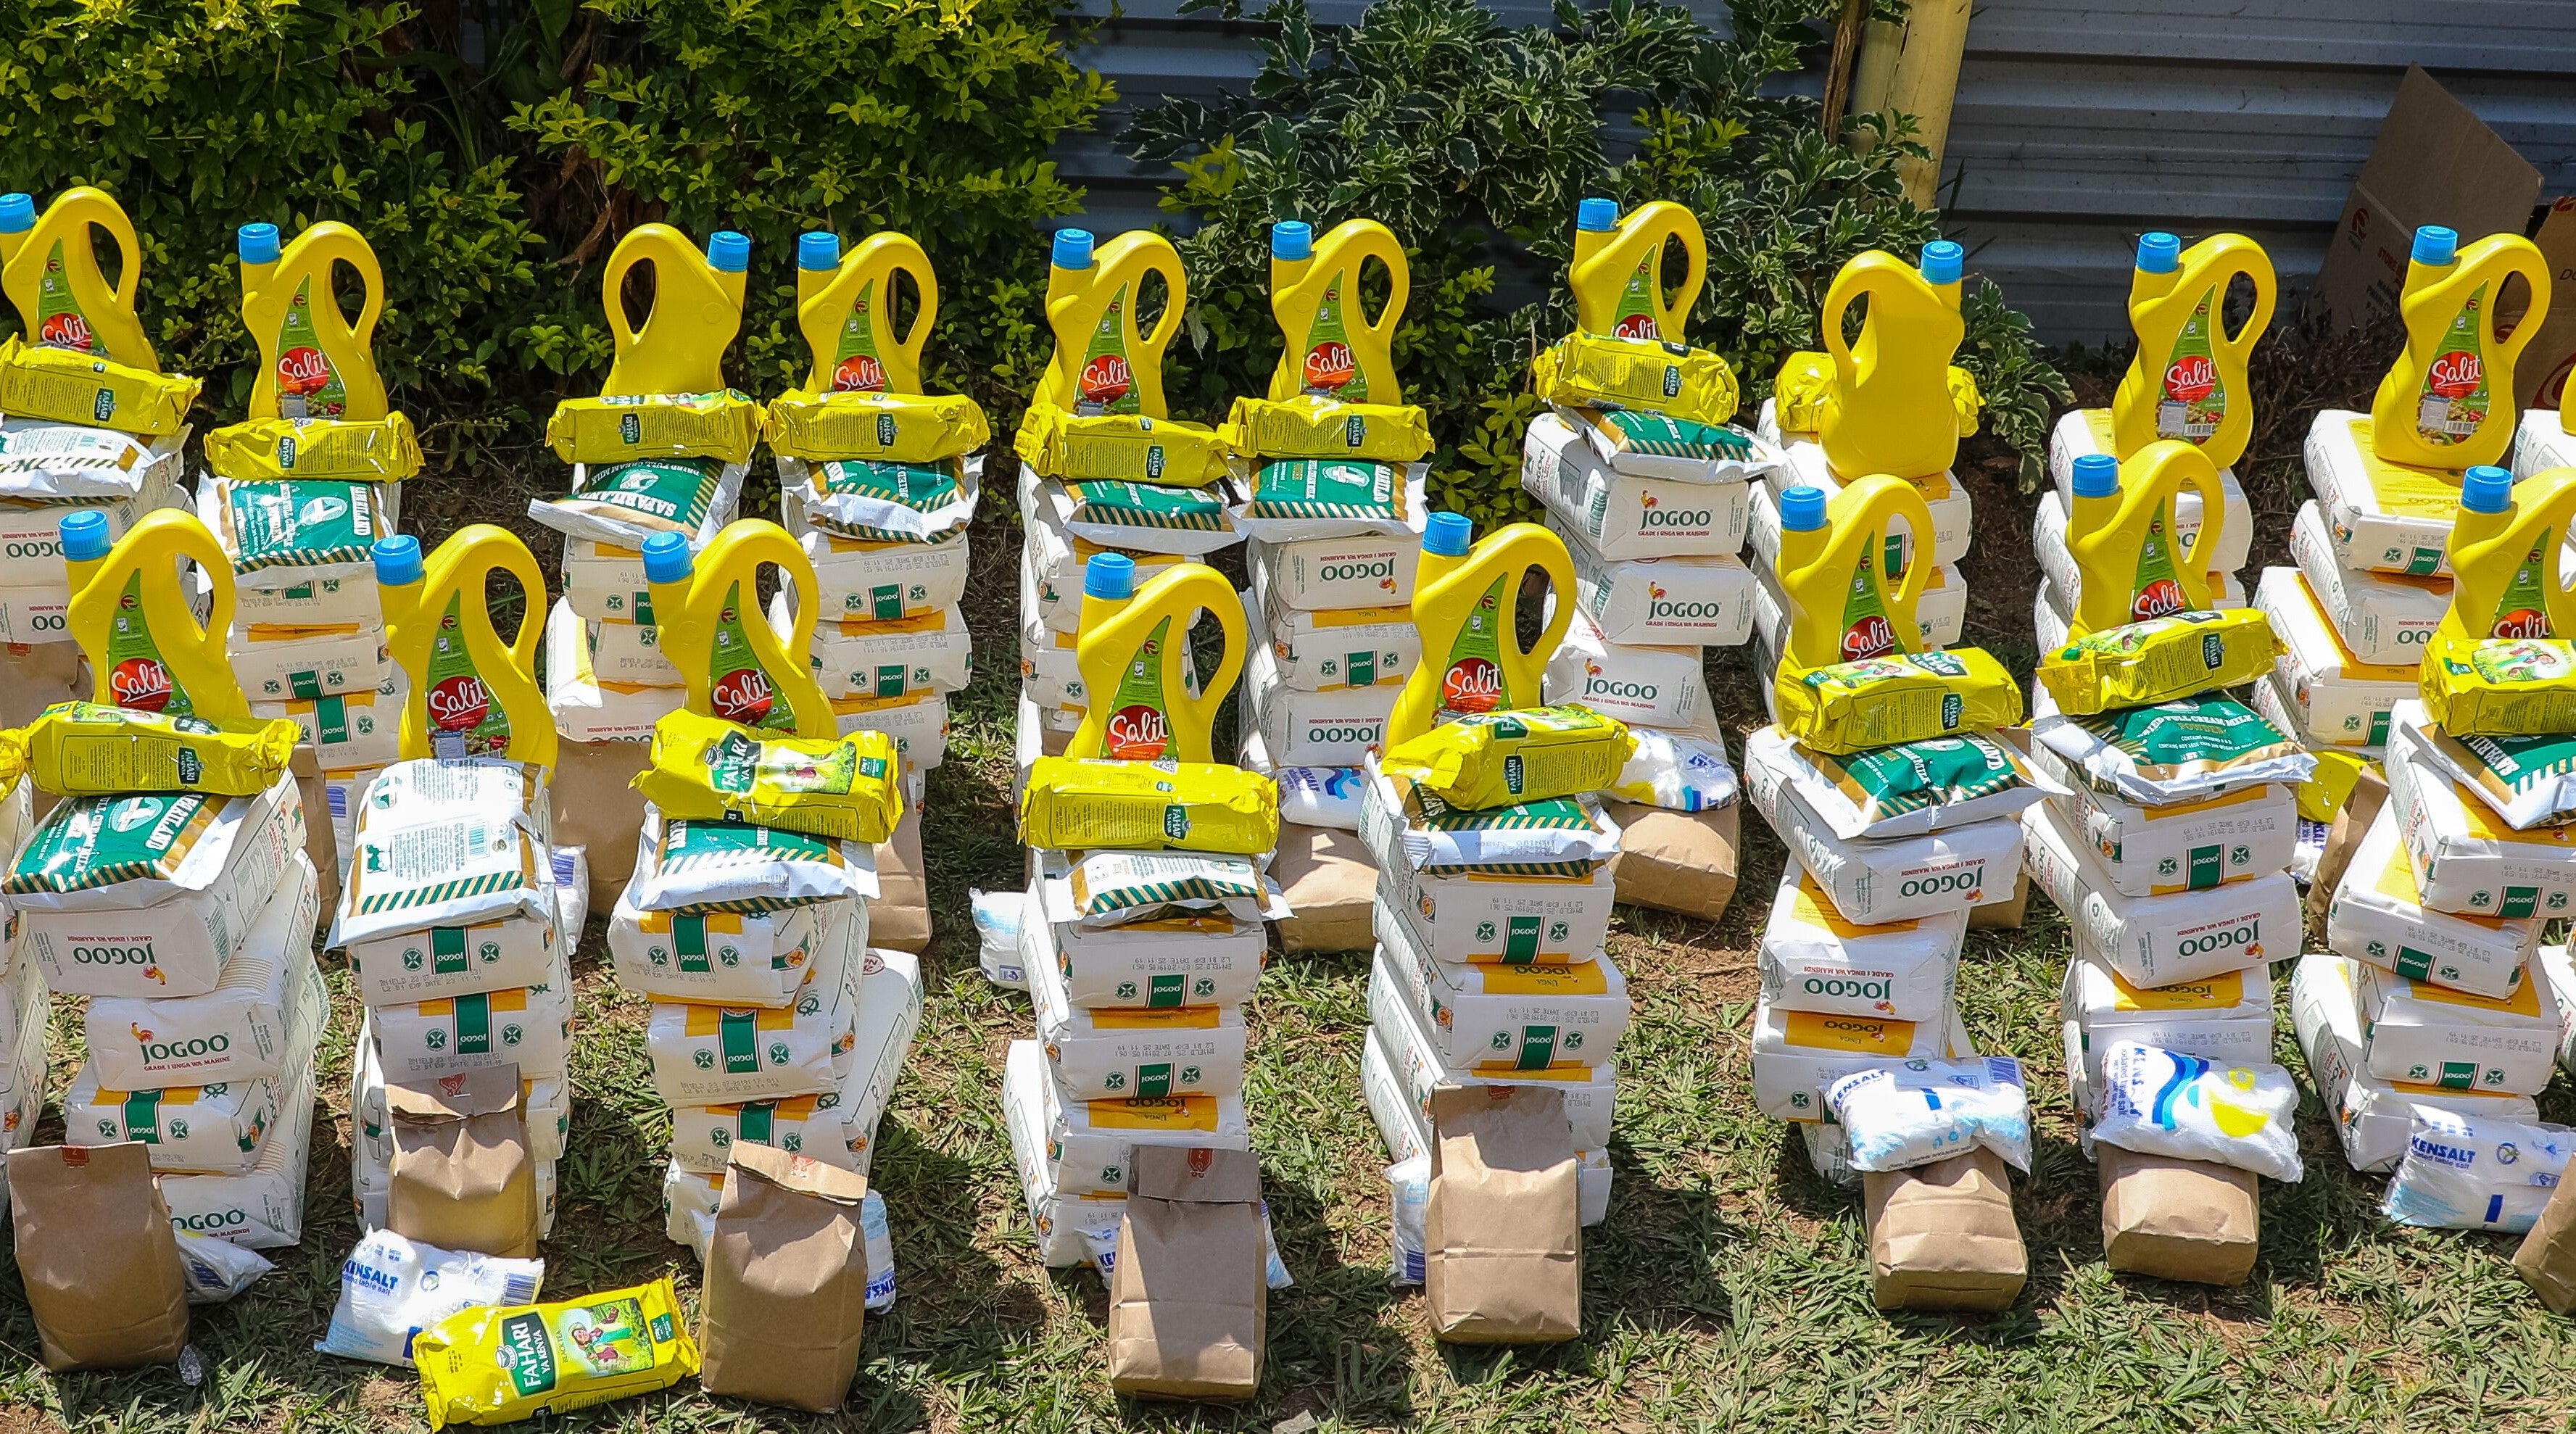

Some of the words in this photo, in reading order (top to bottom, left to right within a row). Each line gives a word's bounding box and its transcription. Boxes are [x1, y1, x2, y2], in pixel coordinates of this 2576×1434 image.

[41, 315, 92, 344] Salit
[278, 349, 329, 383] Salit
[835, 358, 885, 391] Salit
[1083, 357, 1130, 391] Salit
[1306, 344, 1354, 378] Salit
[2432, 356, 2482, 386] Salit
[2167, 362, 2216, 392] Salit
[592, 468, 611, 485] MILK
[579, 492, 677, 518] SAFARILAND
[1640, 510, 1711, 530] JOGOO
[1321, 558, 1395, 581] JOGOO
[1647, 601, 1719, 621] JOGOO
[2134, 581, 2184, 619] Salit
[1844, 617, 1894, 652] Salit
[2208, 637, 2219, 666] FAHARI
[111, 660, 172, 702] Salit
[713, 668, 772, 716] Salit
[1446, 664, 1502, 701] Salit
[1584, 678, 1657, 700] JOGOO
[429, 680, 489, 720] Salit
[322, 726, 344, 734] JOGOO
[1110, 710, 1169, 747] Salit
[1309, 724, 1380, 742] JOGOO
[2191, 716, 2227, 726] CREAM
[2227, 714, 2254, 727] MILK
[185, 750, 194, 780] FAHARI
[721, 737, 747, 788] FAHARI
[146, 794, 202, 850] AFARILAND
[273, 811, 290, 863] JOGOO
[2192, 856, 2218, 866] JOGOO
[1900, 866, 1983, 897] JOGOO
[2179, 919, 2260, 957] JOGOO
[73, 942, 156, 964] JOGOO
[437, 951, 463, 962] JOGOO
[2401, 956, 2427, 969] JOGOO
[1515, 966, 1571, 975] JOGOO
[1804, 979, 1891, 1000] JOGOO
[460, 1033, 486, 1043] JOGOO
[1824, 1020, 1884, 1033] JOGOO
[1839, 1035, 1861, 1045] UNGA
[140, 1035, 230, 1066] JOGOO
[728, 1053, 754, 1062] JOGOO
[1125, 1097, 1185, 1108] JOGOO
[2411, 1135, 2476, 1164] KENSALT
[170, 1209, 246, 1230] OGOO
[377, 1285, 391, 1296] salt
[511, 1321, 541, 1388] FAHARI
[534, 1330, 547, 1362] KENYA
[541, 1363, 550, 1375] YA
